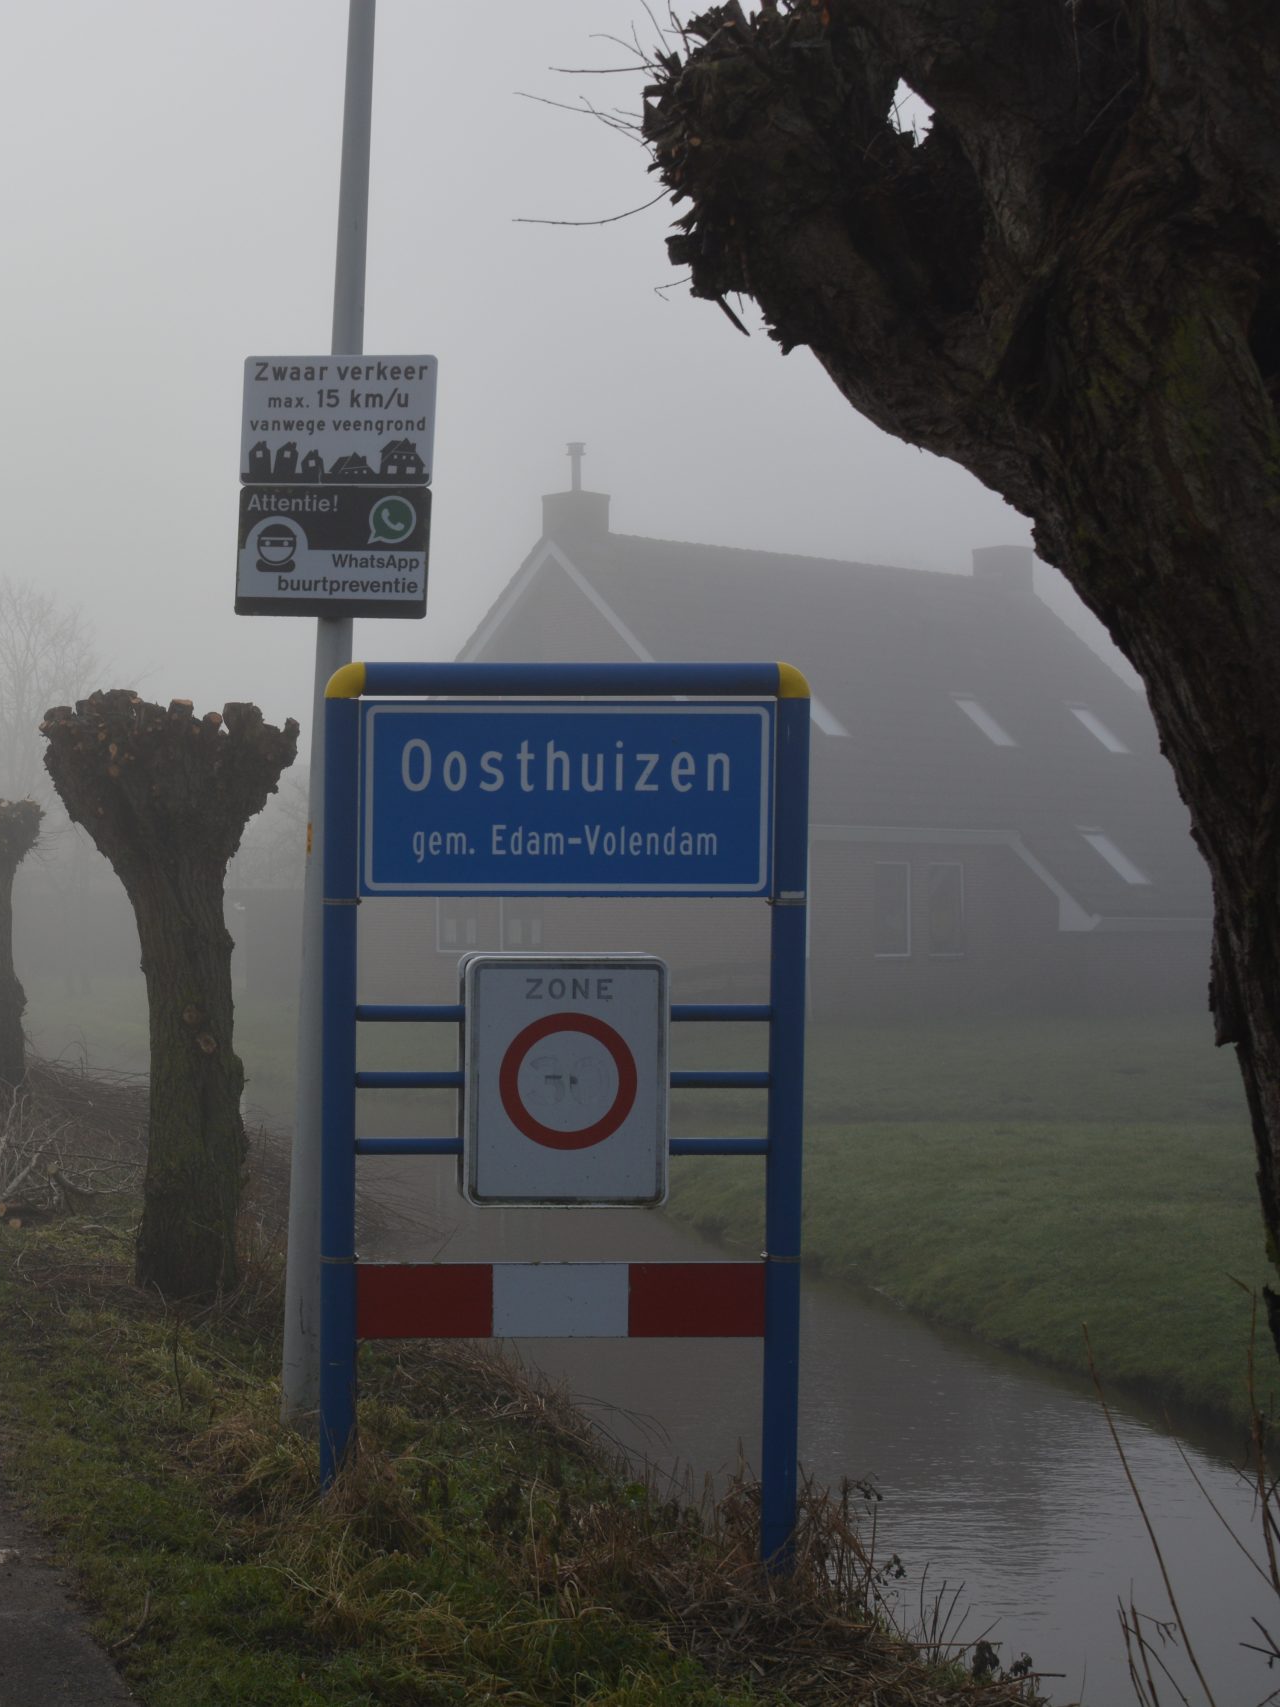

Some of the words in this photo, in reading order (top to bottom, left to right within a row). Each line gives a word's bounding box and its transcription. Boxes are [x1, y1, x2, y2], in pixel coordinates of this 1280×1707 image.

[254, 362, 328, 382] Zwaar
[337, 361, 428, 381] verkeer
[267, 396, 310, 409] max.
[317, 389, 340, 408] 15
[350, 388, 409, 409] km/u
[250, 418, 326, 435] vanwege
[332, 416, 426, 435] veengrond
[247, 494, 339, 512] Attentie!
[331, 553, 420, 572] WhatsApp
[277, 575, 418, 595] buurtpreventie
[401, 738, 731, 793] Oosthuizen
[412, 830, 476, 863] gem.
[491, 824, 718, 856] Edam-Volendam
[525, 978, 614, 1000] ZONE
